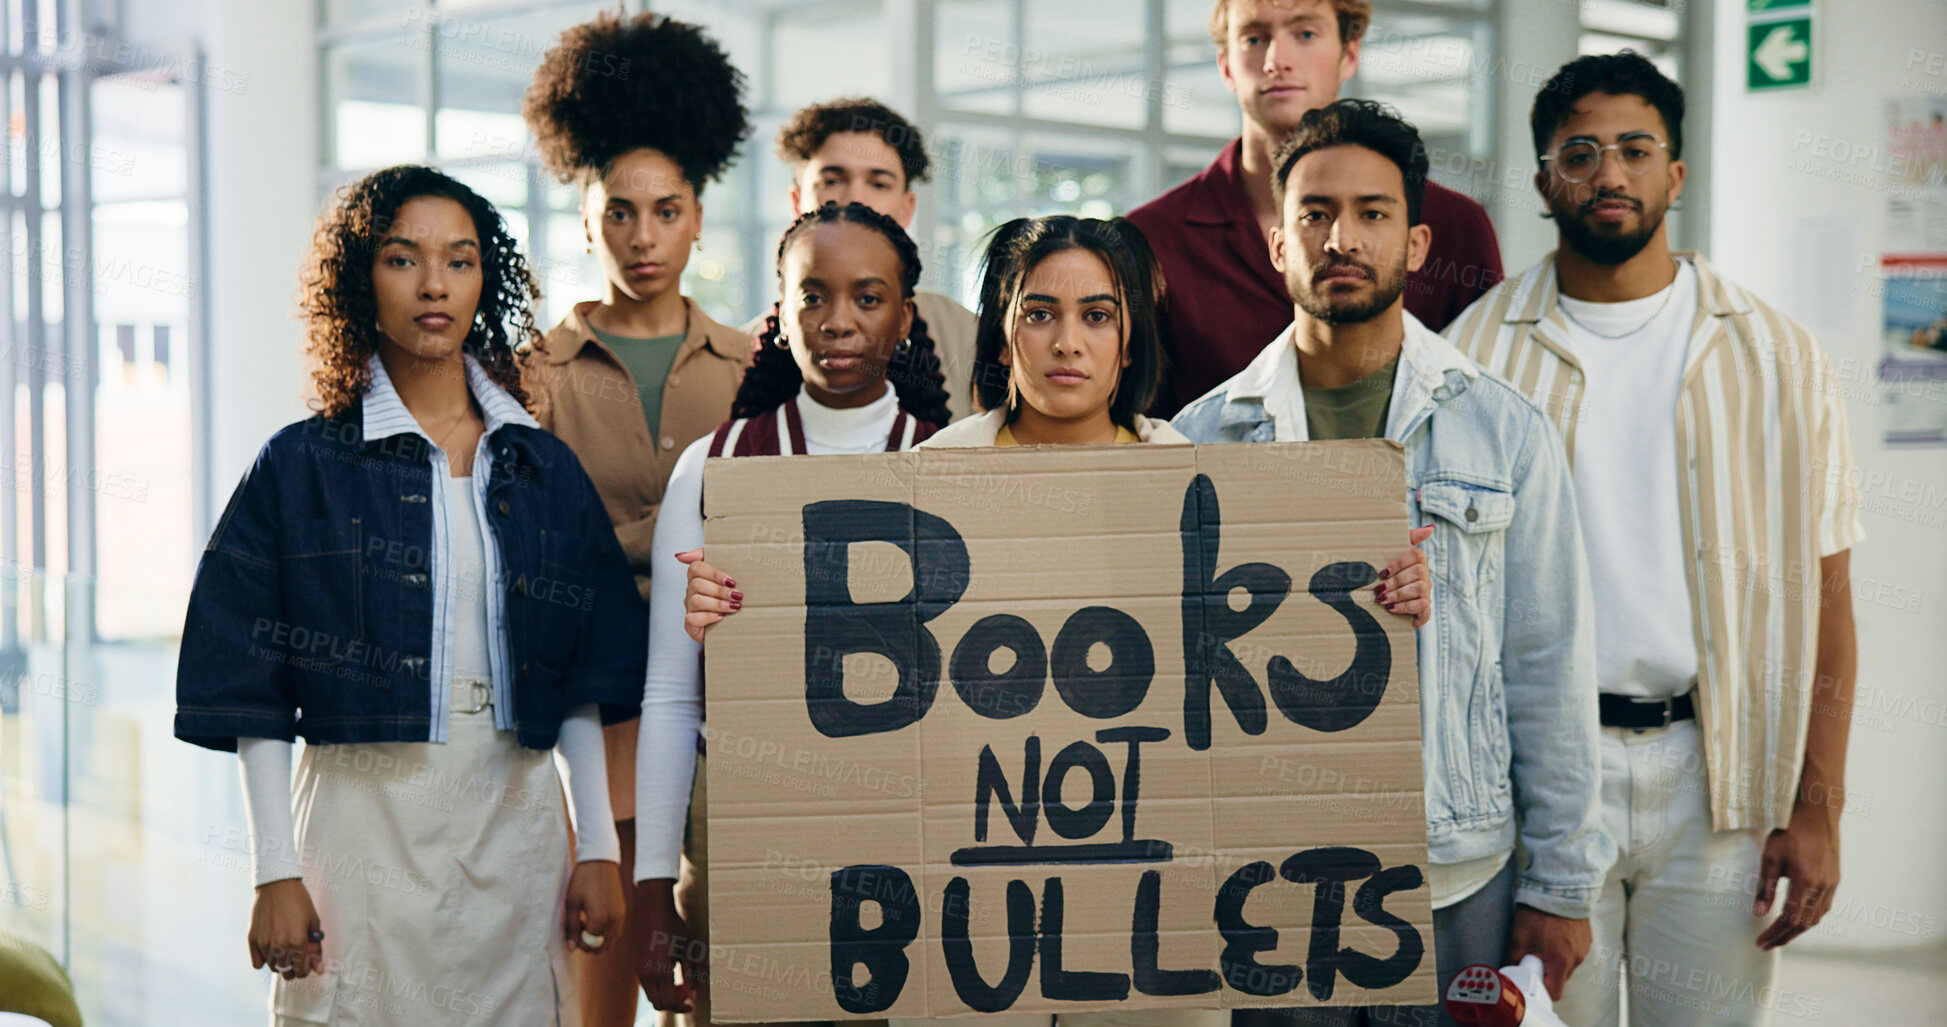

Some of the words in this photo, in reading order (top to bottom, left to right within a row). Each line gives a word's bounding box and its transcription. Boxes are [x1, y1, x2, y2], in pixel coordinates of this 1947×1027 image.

[803, 473, 1391, 751] Books
[975, 726, 1172, 846] NOT
[830, 846, 1425, 1014] BULLETS
